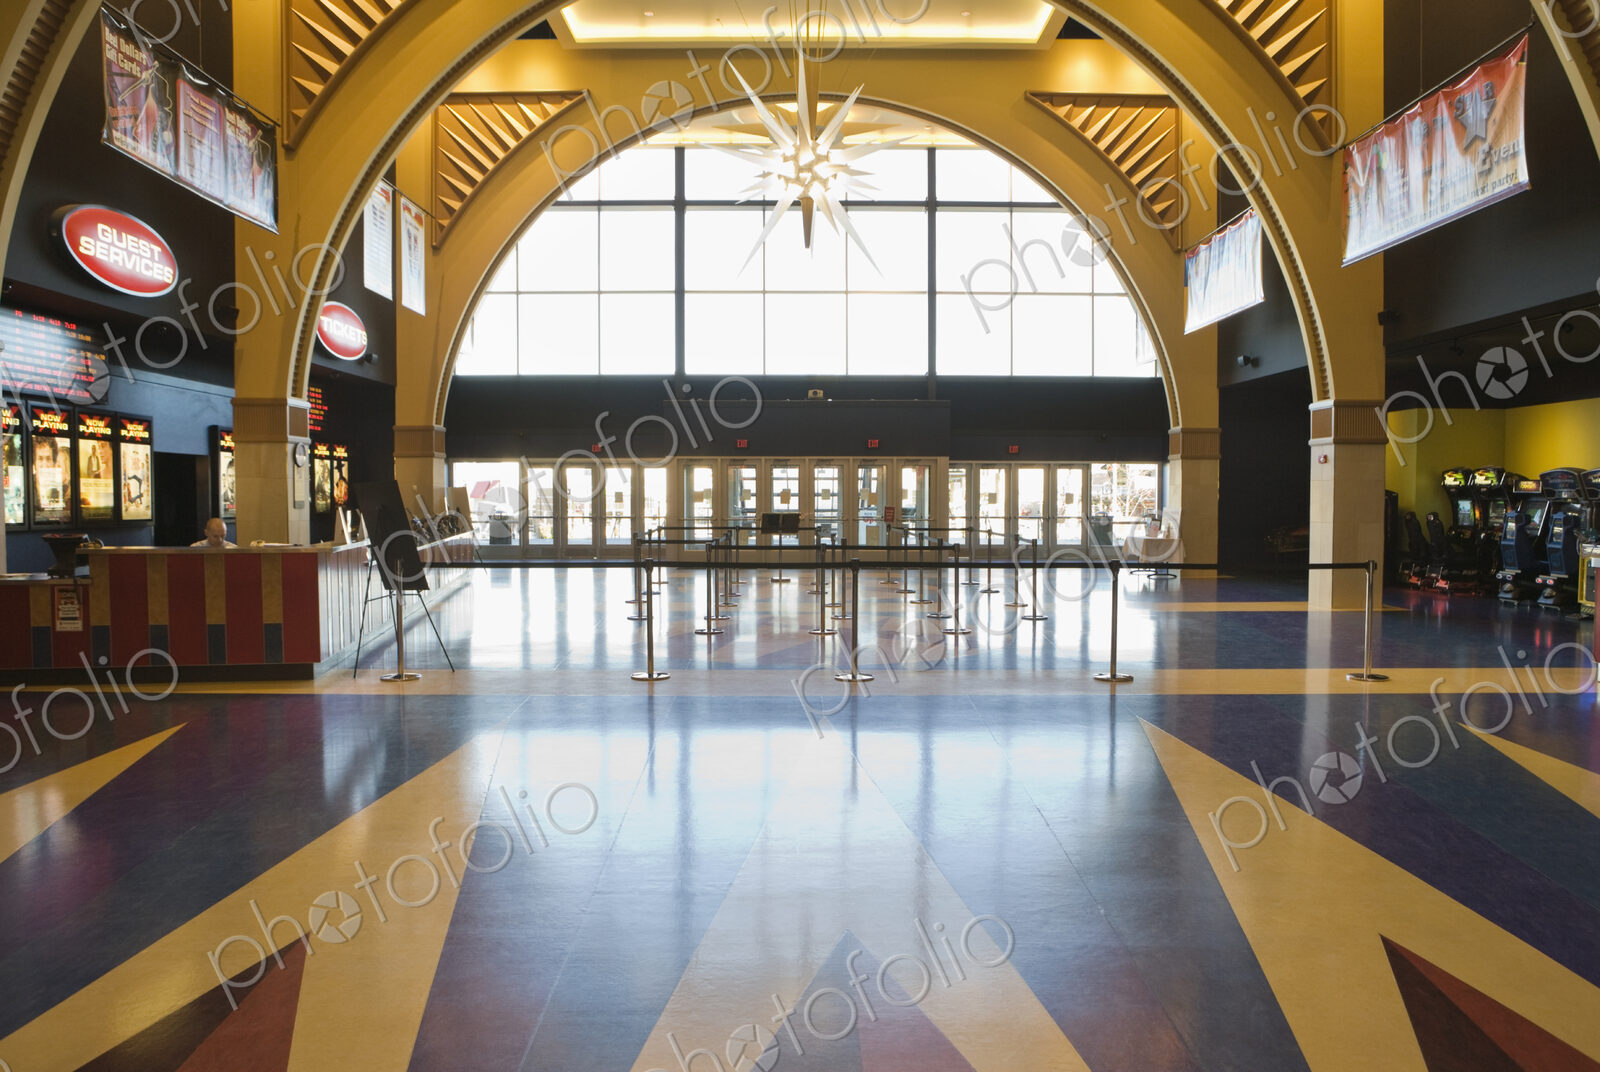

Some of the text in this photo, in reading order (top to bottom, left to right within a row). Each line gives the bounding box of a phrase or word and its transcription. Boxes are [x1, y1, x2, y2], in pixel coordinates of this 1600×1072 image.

[1491, 169, 1518, 191] party!
[97, 223, 162, 261] GUEST
[79, 236, 174, 284] SERVICES
[320, 315, 367, 346] TICKETS
[40, 413, 61, 422] NOW
[32, 419, 68, 430] PLAYING
[86, 419, 104, 427] NOW
[79, 425, 111, 435] PLAYING
[121, 429, 149, 438] PLAYING
[737, 439, 748, 448] EXIT
[868, 439, 879, 448] EXIT
